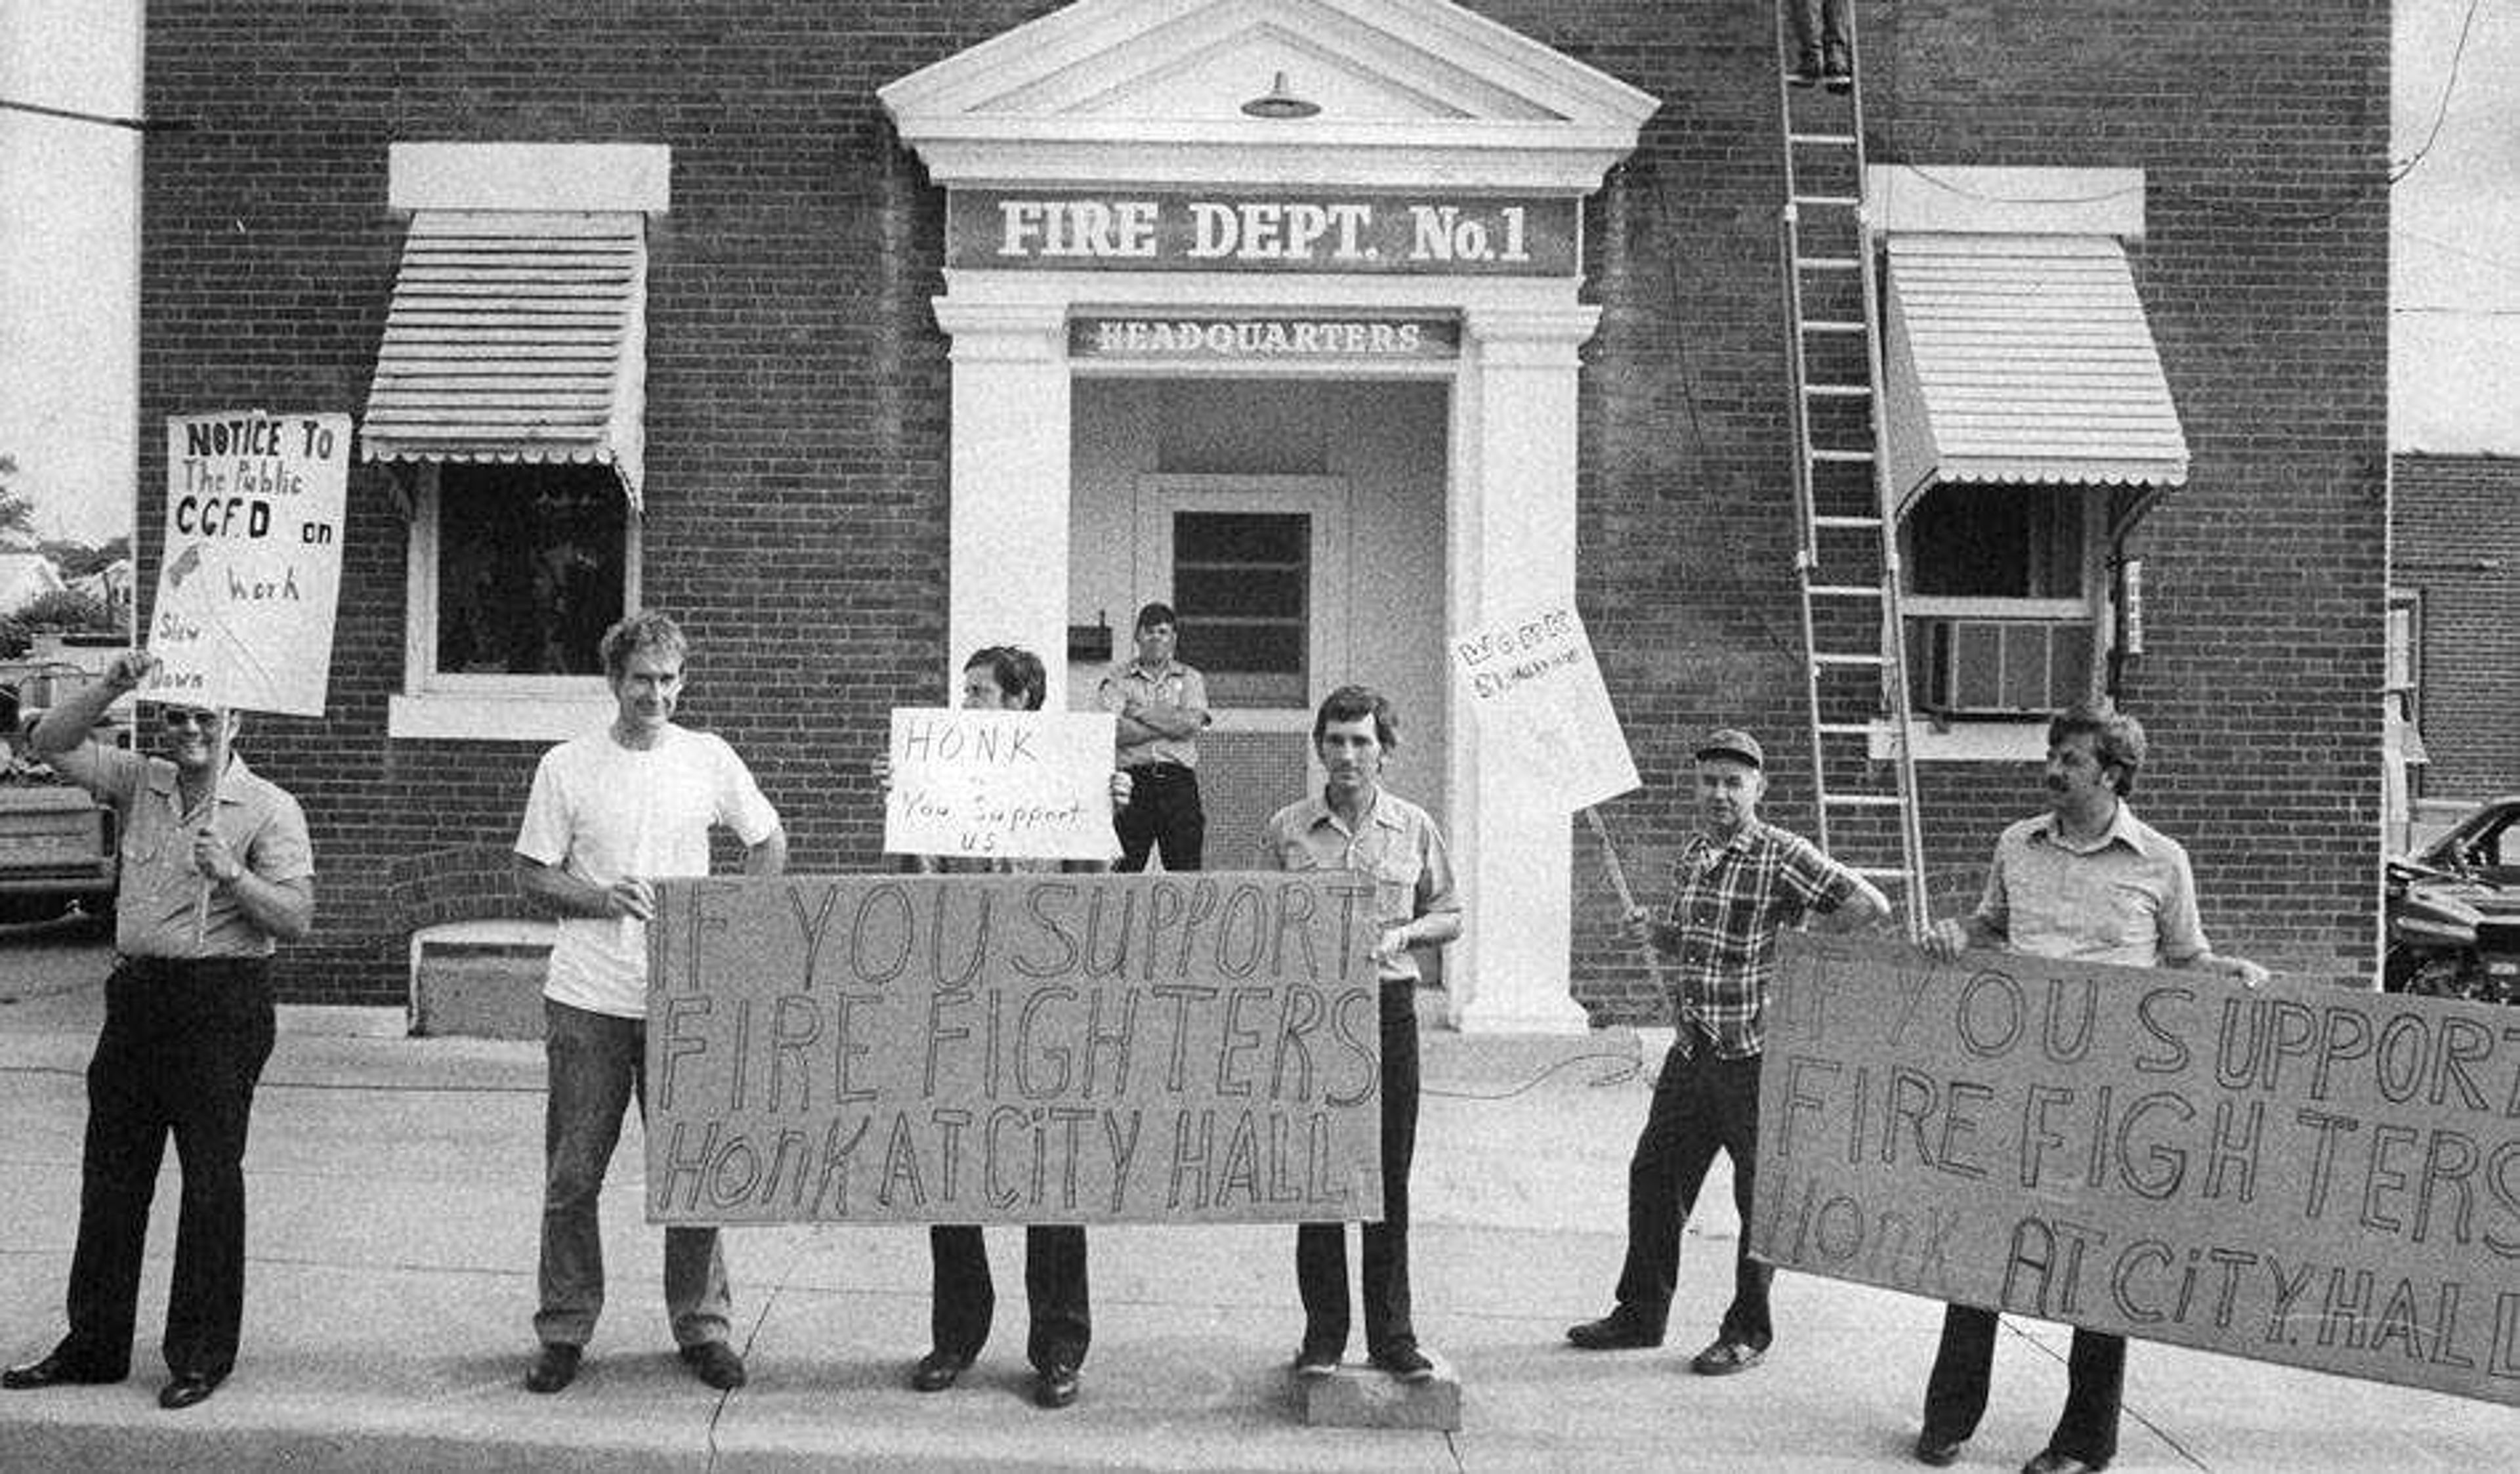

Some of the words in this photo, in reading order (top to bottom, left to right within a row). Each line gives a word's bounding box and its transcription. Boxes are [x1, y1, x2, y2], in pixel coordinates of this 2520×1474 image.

[998, 201, 1158, 257] FIRE
[1188, 203, 1379, 259] DEPT.
[1410, 205, 1529, 263] No.1
[1098, 321, 1420, 353] HEADQUARTERS
[186, 421, 282, 456] NOTICE
[303, 421, 333, 459] TO
[184, 461, 224, 491] The
[234, 459, 303, 494] Public
[303, 523, 331, 544] on
[905, 721, 1038, 761] HONK
[903, 791, 950, 819] You
[654, 883, 736, 990] IF
[788, 885, 988, 990] YOU
[1011, 883, 1376, 980] SUPPORT
[659, 992, 885, 1112] FIRE
[923, 984, 1377, 1108] FIGHTERS
[1889, 970, 2098, 1064] YOU
[1776, 1057, 1994, 1179] FIRE
[879, 1110, 971, 1206] AT
[1166, 1109, 1348, 1209] HALL
[2318, 1265, 2520, 1379] HALL
